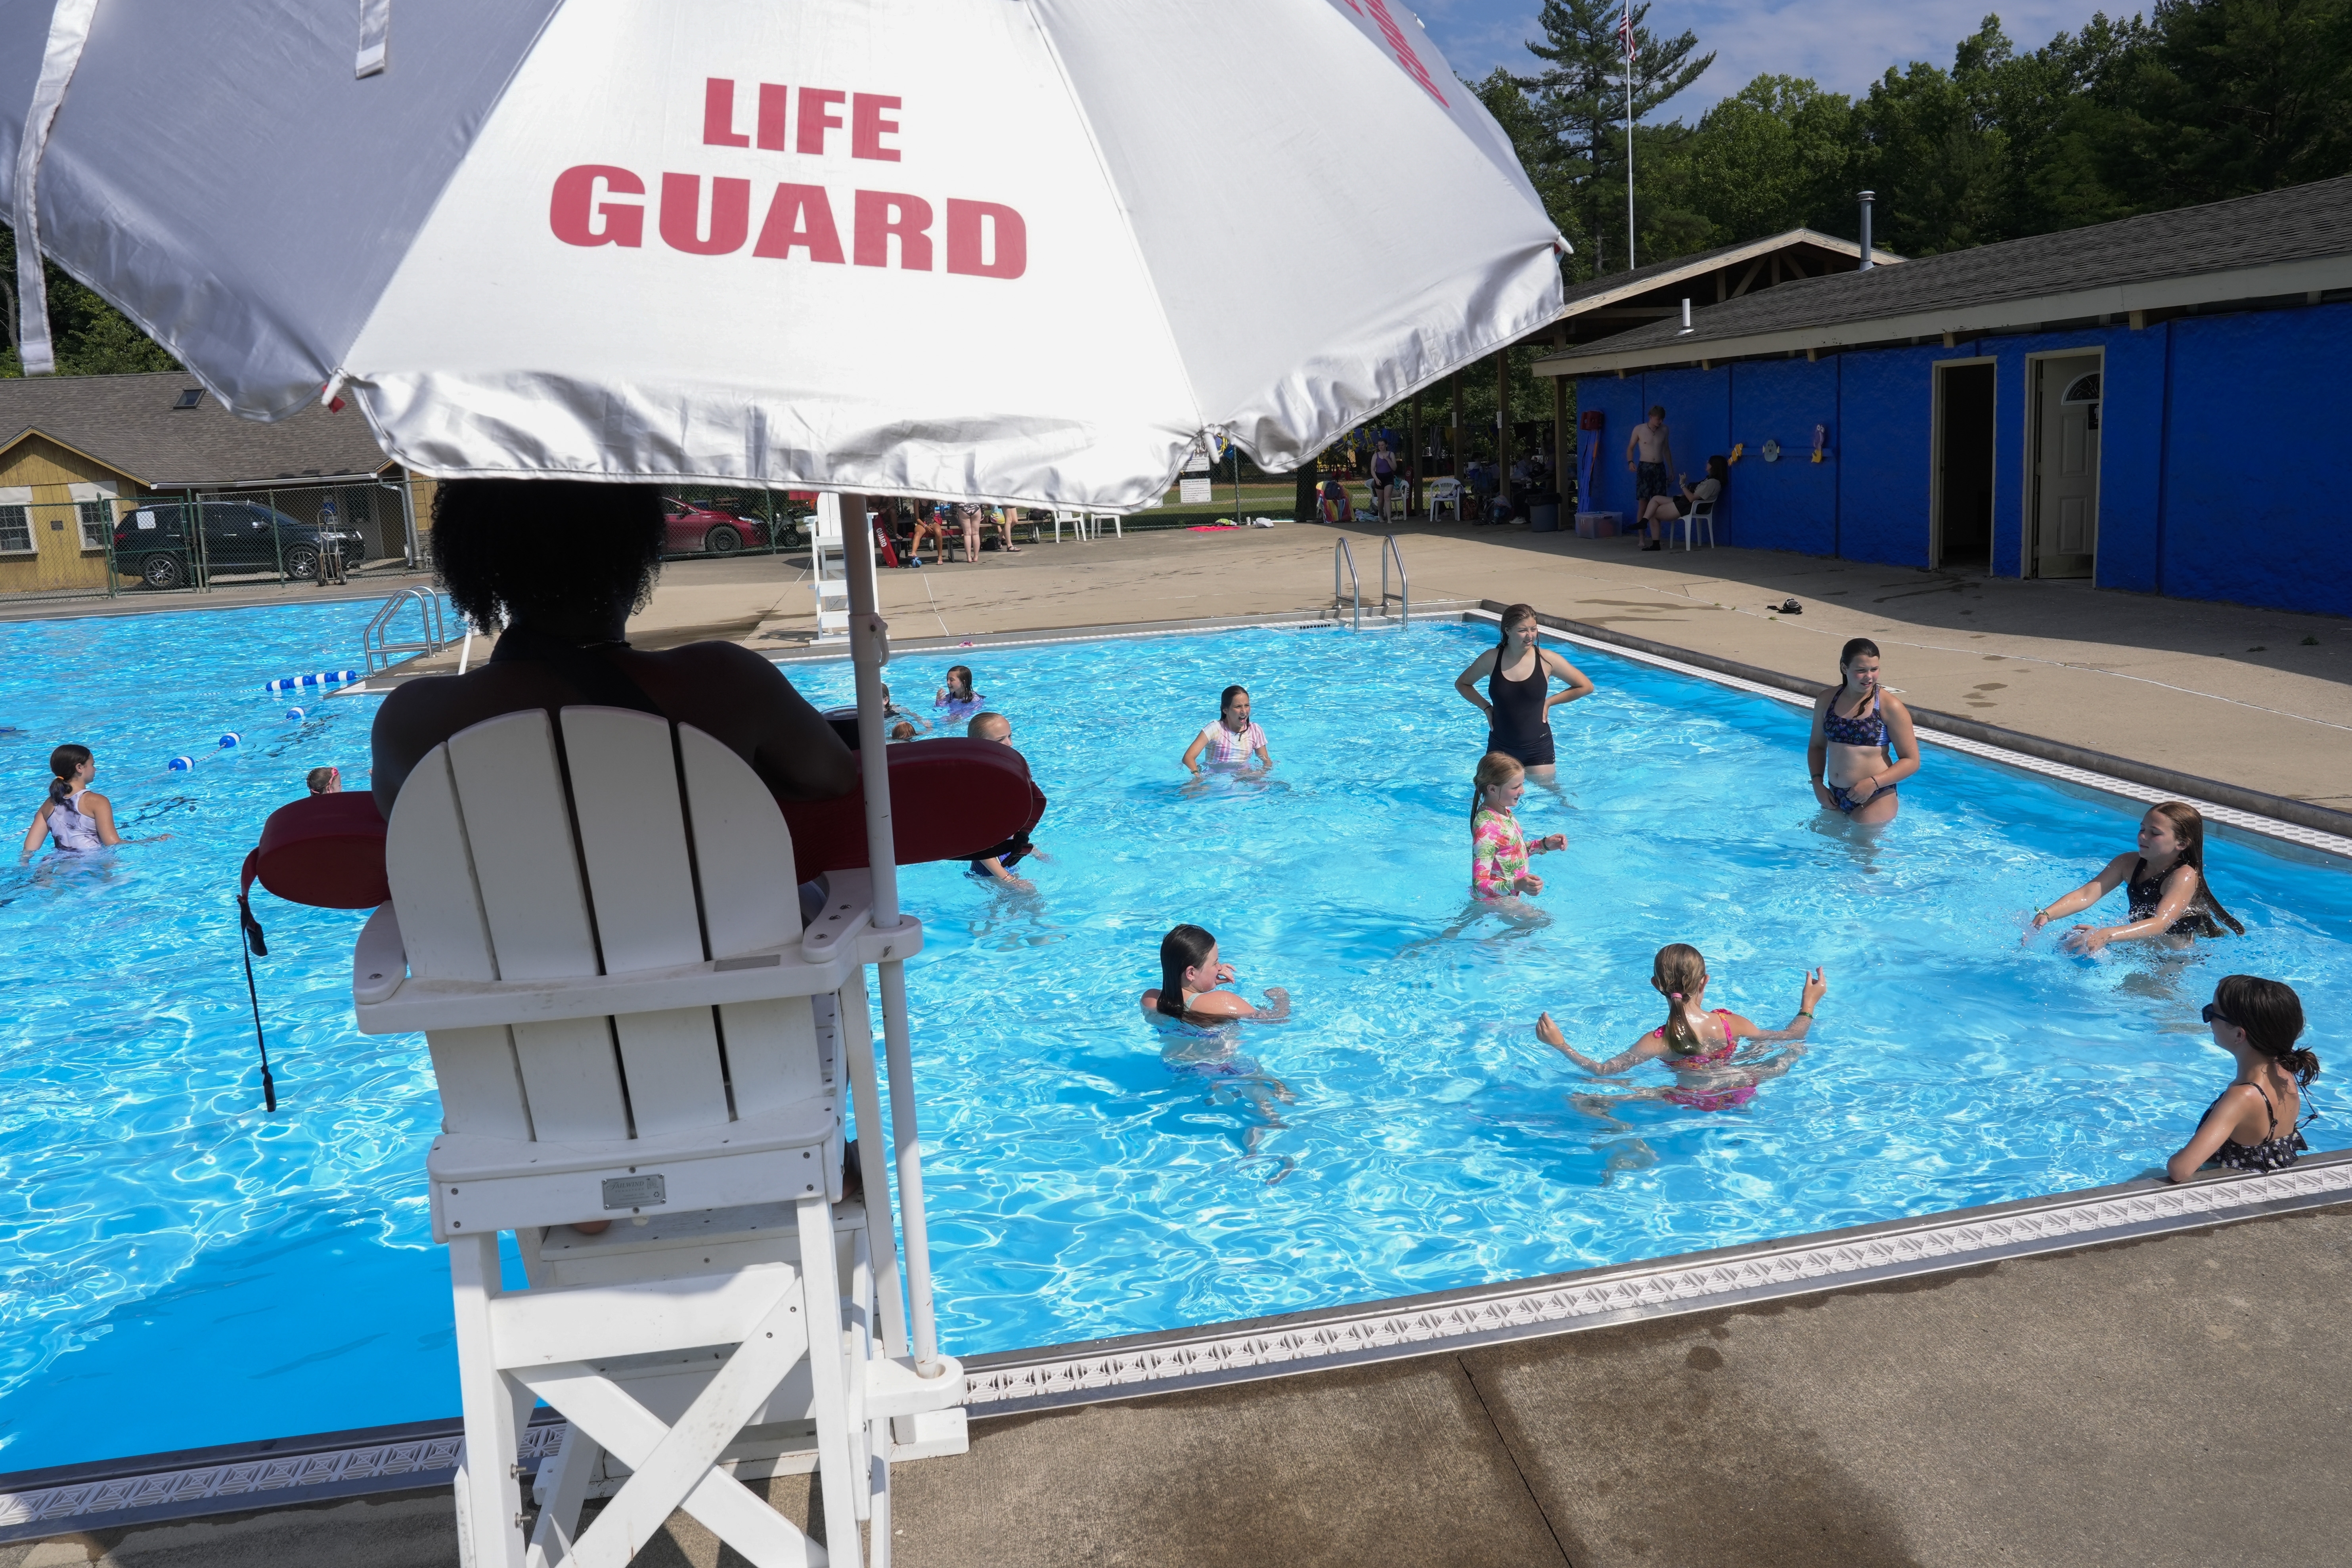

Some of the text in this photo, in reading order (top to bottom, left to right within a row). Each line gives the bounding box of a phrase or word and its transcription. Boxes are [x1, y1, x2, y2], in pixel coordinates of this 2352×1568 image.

[704, 78, 901, 161] LIFE
[551, 165, 1026, 278] GUARD
[876, 528, 887, 547] GUARD
[606, 1182, 644, 1190] TAILWIND
